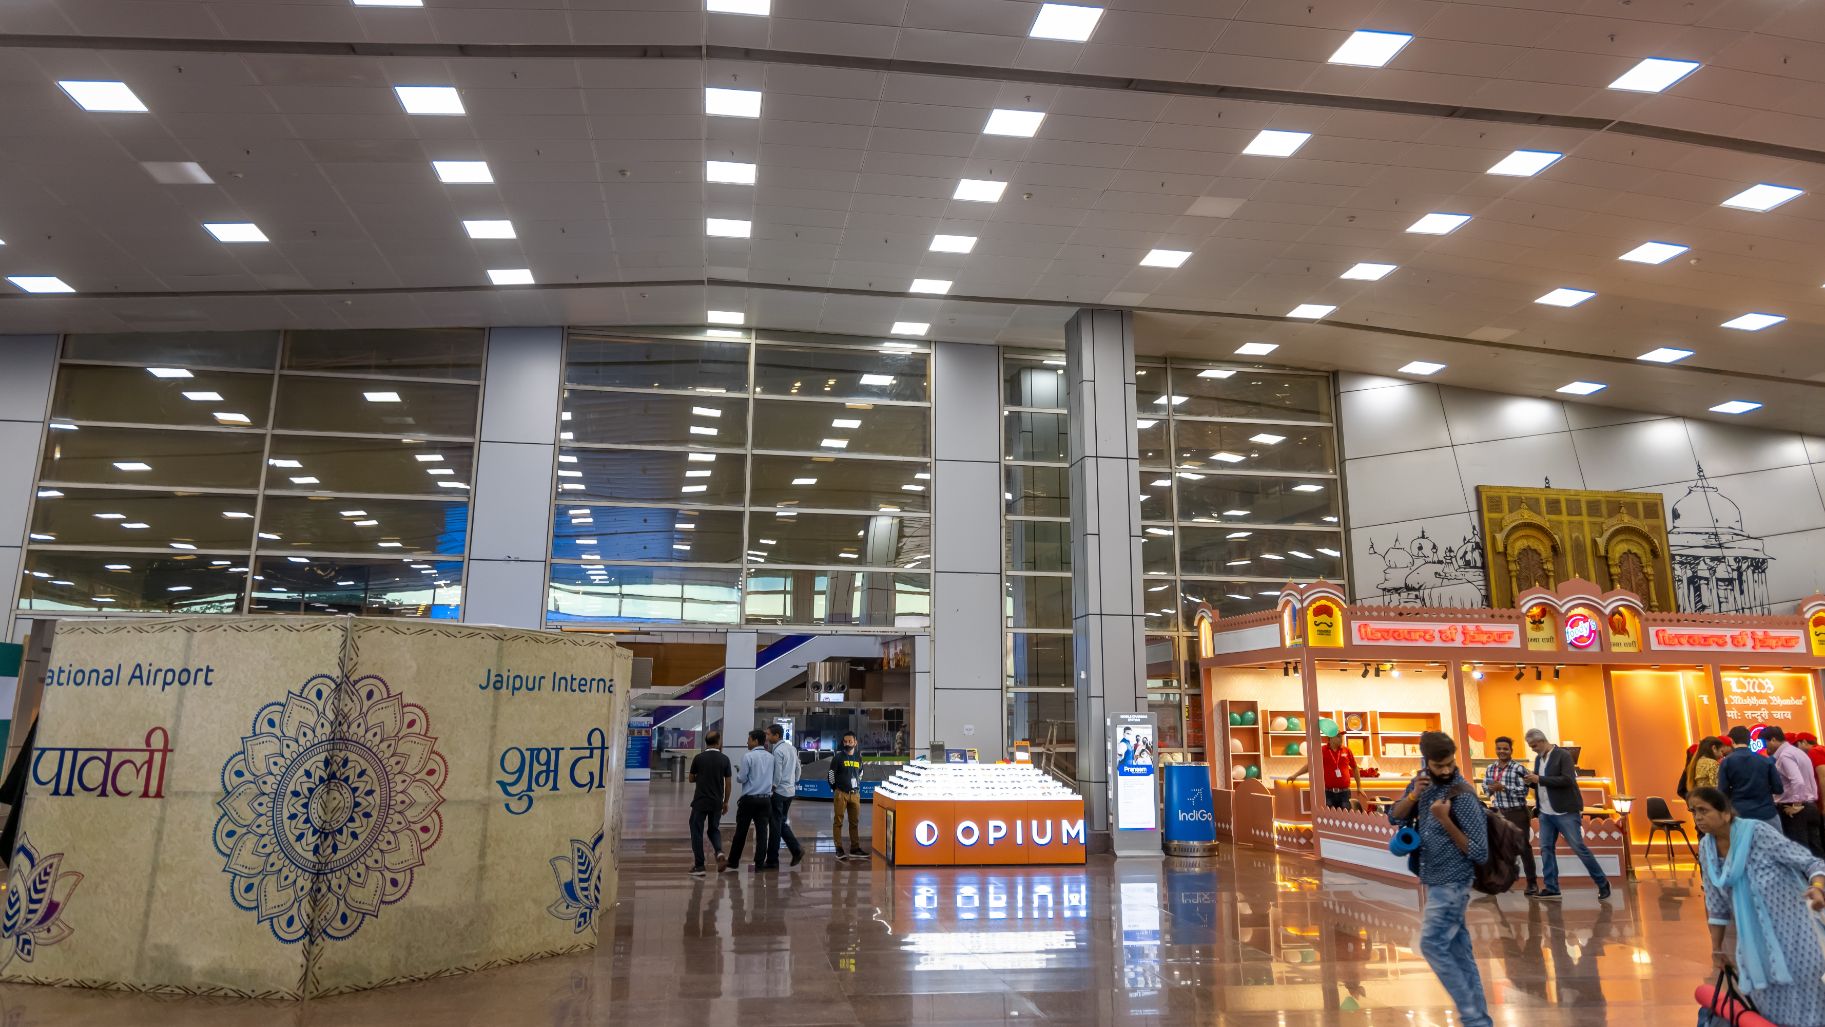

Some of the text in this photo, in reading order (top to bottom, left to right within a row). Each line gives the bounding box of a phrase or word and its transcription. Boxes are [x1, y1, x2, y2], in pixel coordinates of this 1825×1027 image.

[1439, 625, 1458, 642] of
[1730, 630, 1749, 648] of
[128, 663, 214, 691] Airport
[479, 669, 546, 696] Jaipur
[1726, 708, 1741, 720] मो:
[1771, 710, 1792, 720] चाय
[32, 726, 174, 799] पावली
[496, 746, 565, 815] शुभ
[569, 727, 609, 793] दी
[1178, 809, 1213, 821] IndiGo
[956, 819, 1087, 846] OPIUM
